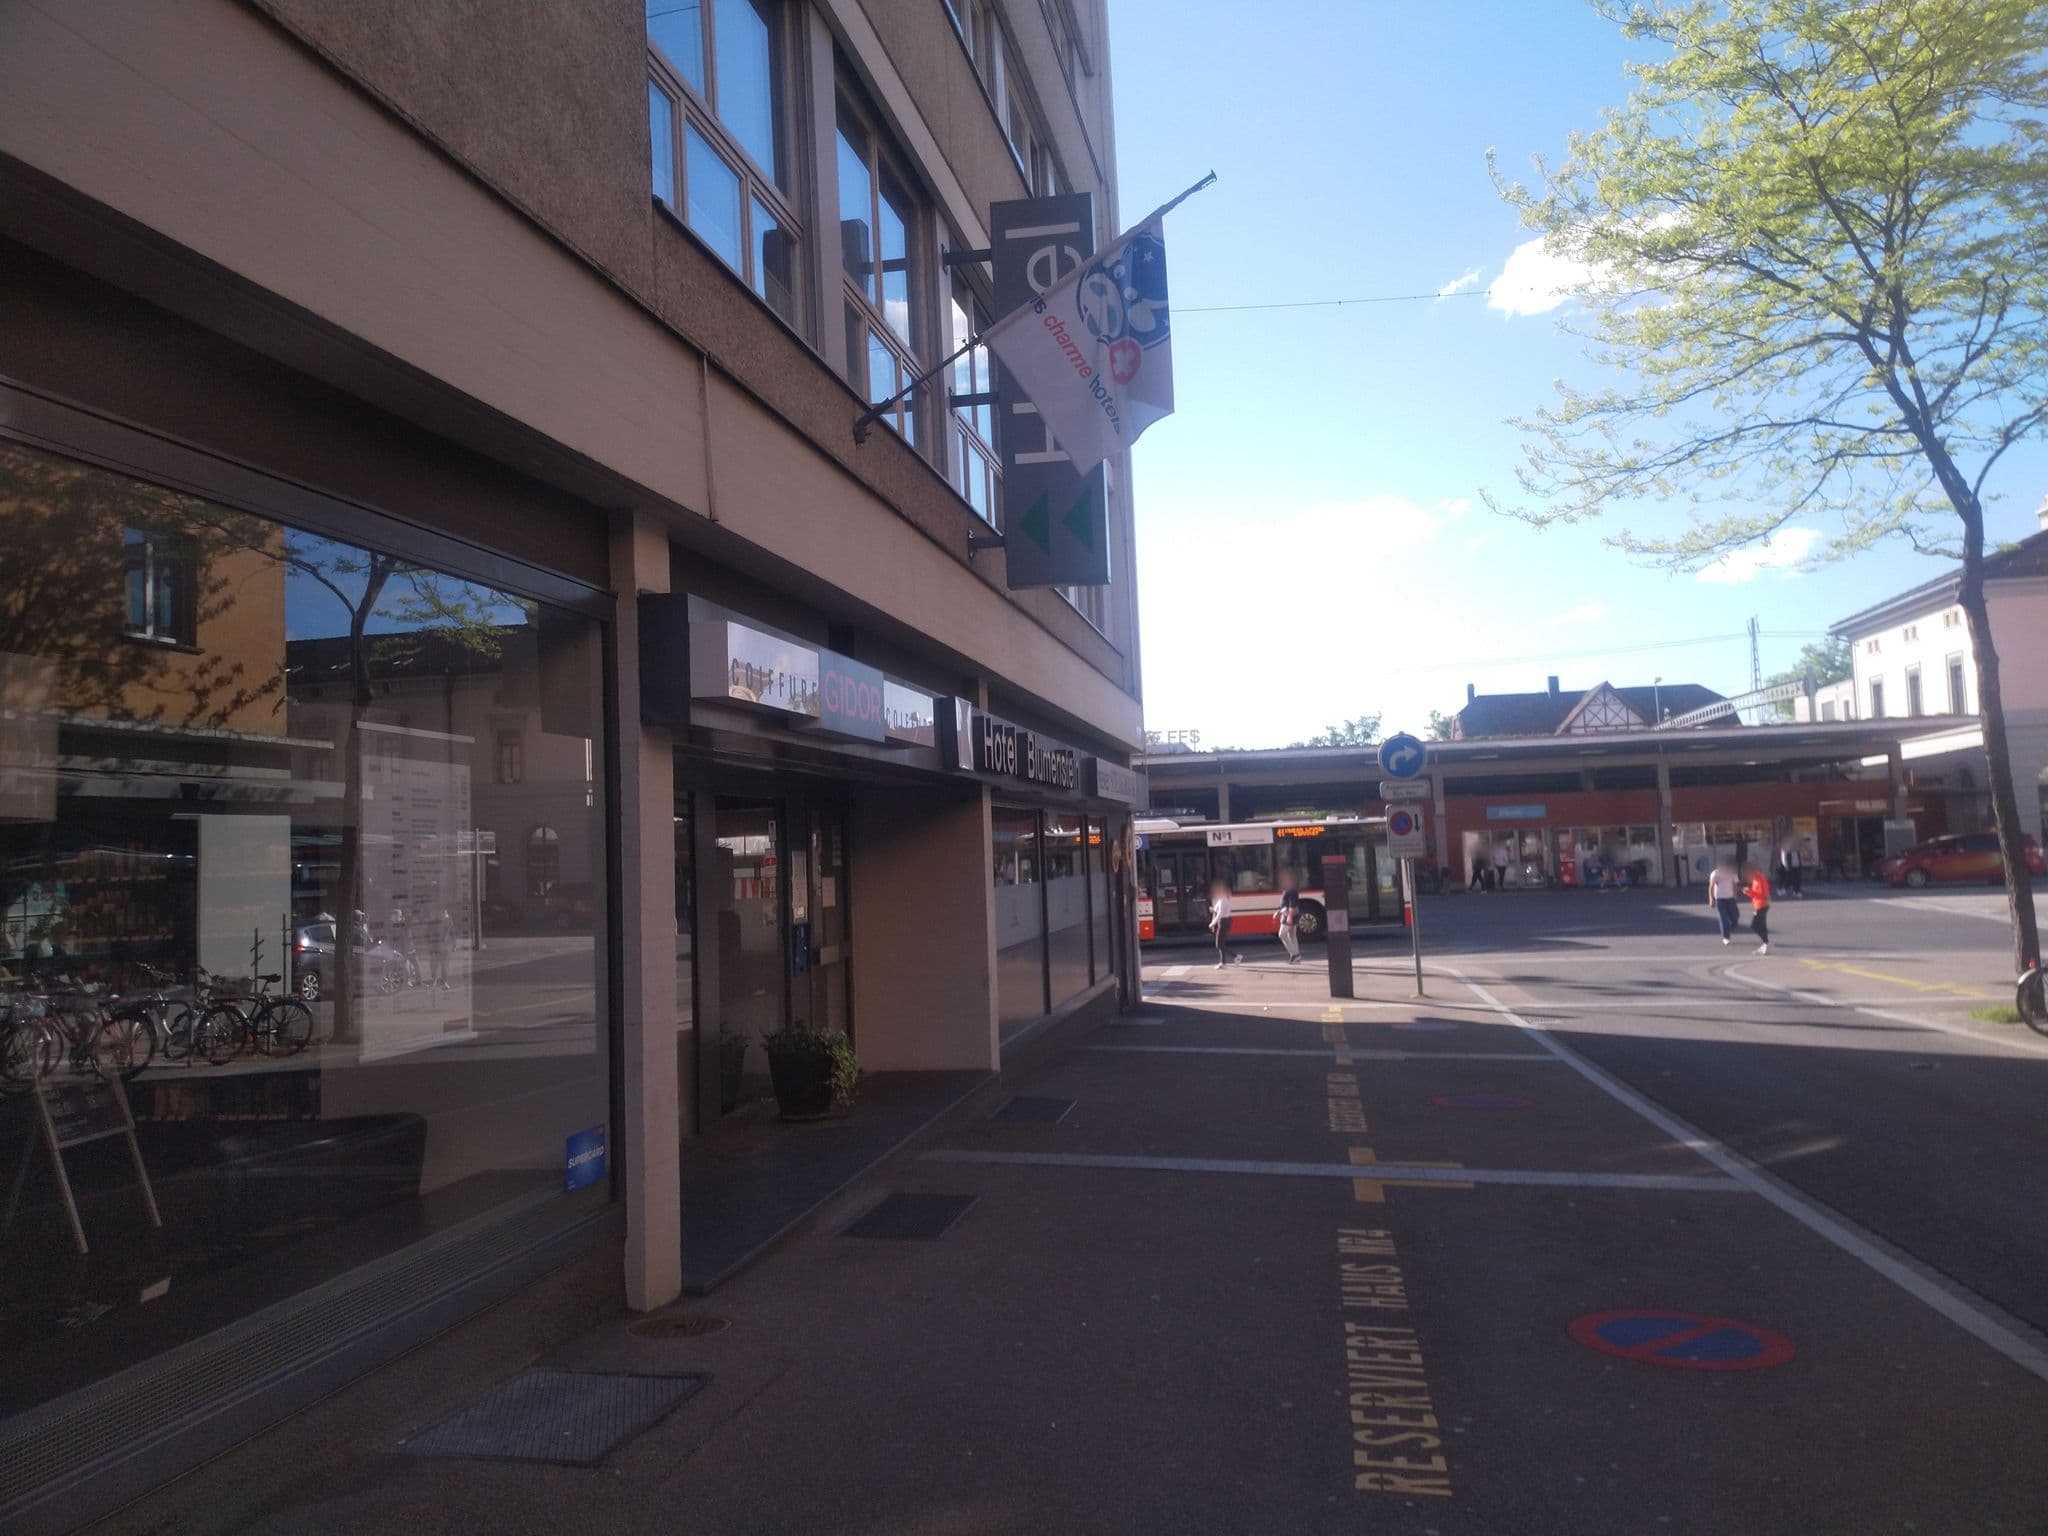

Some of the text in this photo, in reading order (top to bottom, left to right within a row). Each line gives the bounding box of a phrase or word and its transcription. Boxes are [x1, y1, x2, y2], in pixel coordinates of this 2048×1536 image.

[1043, 315, 1093, 380] charme
[823, 668, 881, 725] GIDOR
[984, 717, 1018, 776] Hotel
[1027, 734, 1081, 790] Blumenstein
[1341, 1262, 1409, 1310] HAUS
[1344, 1322, 1453, 1497] RESERVIERT
